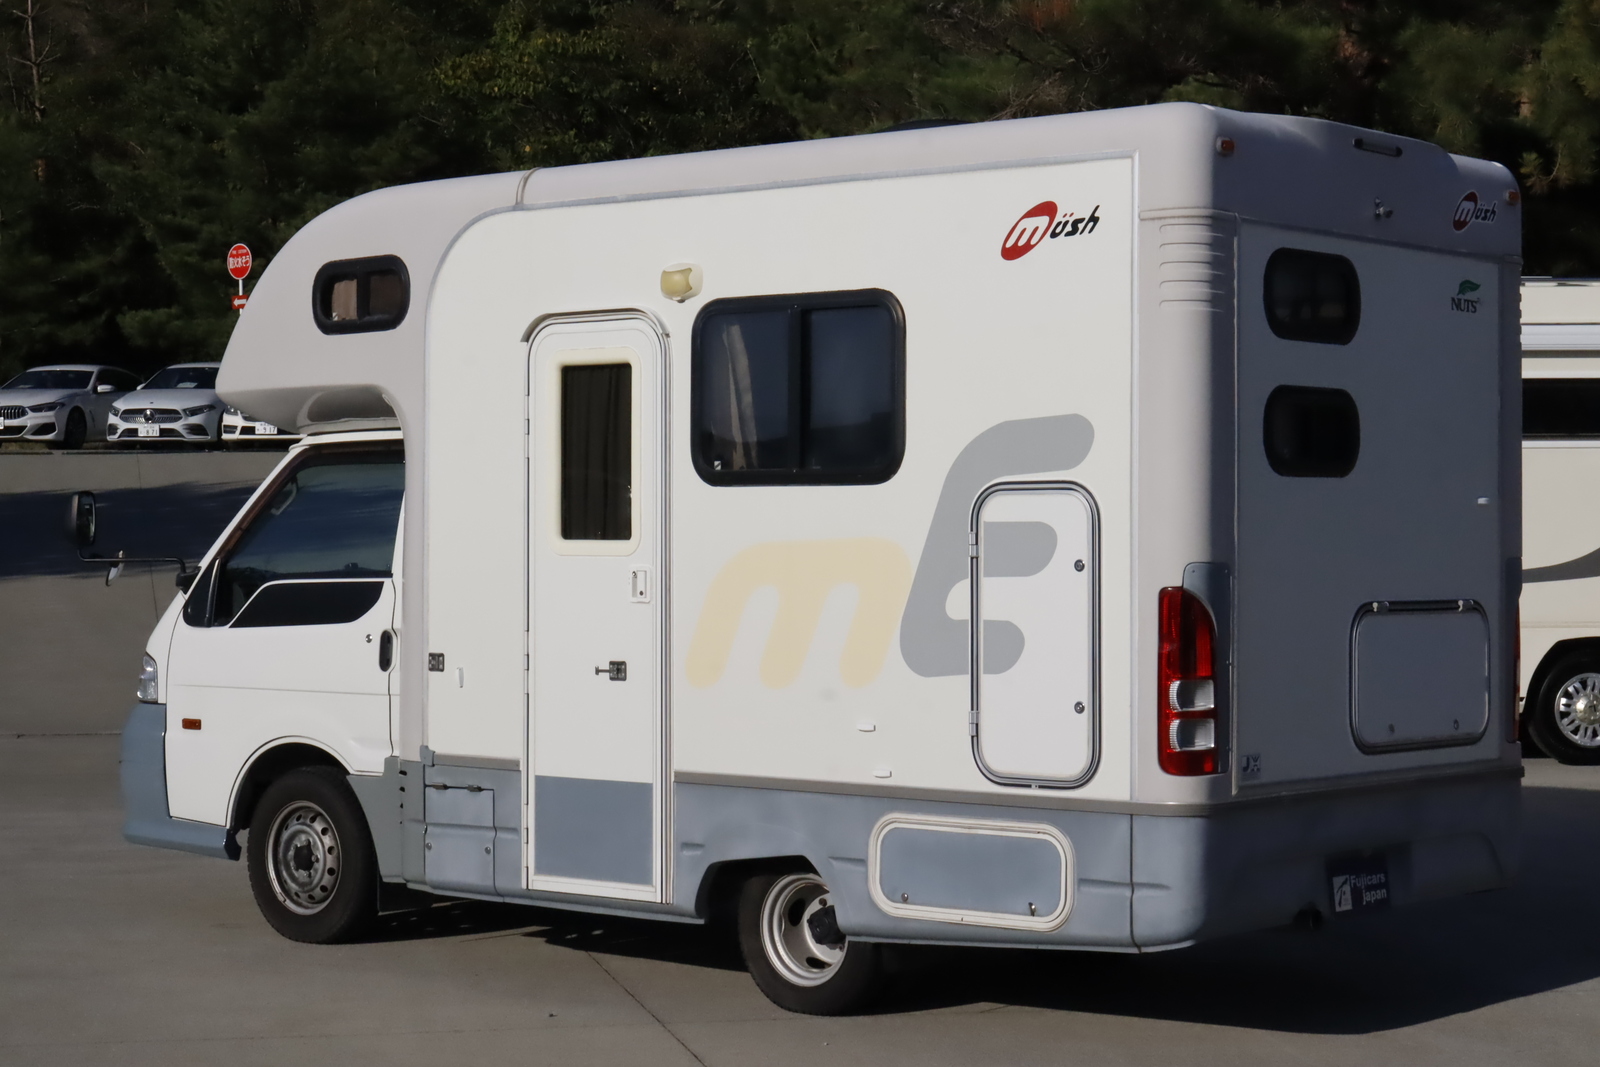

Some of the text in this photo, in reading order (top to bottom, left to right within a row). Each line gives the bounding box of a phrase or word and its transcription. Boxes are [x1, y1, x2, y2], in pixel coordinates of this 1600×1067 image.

[1451, 297, 1478, 313] NUTS
[1350, 873, 1386, 889] Fujicars
[1363, 888, 1387, 905] japan
